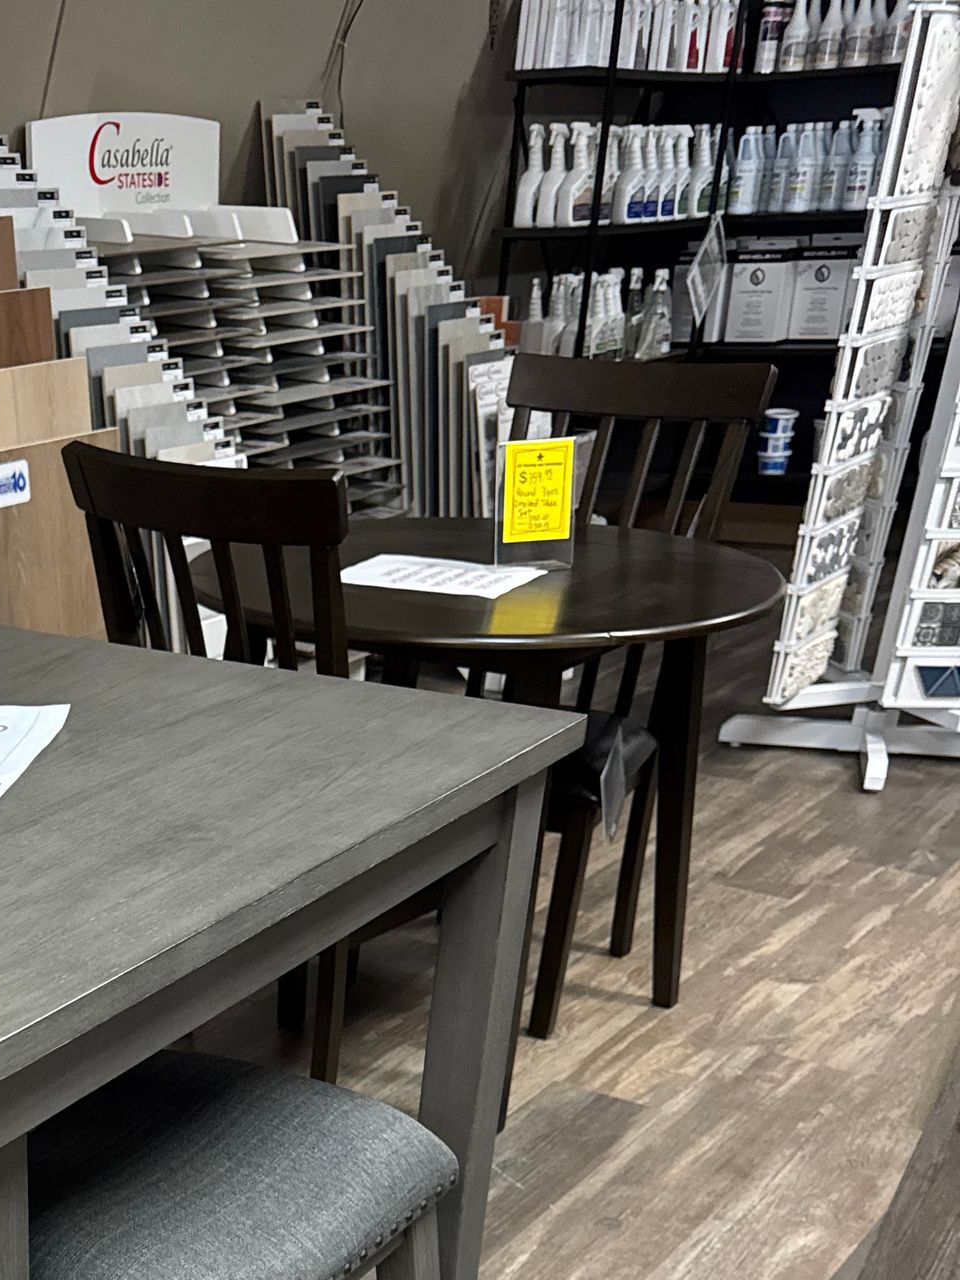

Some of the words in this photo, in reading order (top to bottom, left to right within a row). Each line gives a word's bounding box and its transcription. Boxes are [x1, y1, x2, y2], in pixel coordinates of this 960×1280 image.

[88, 121, 171, 186] Casabella
[117, 171, 171, 190] STATESIDE
[135, 192, 171, 205] Collection
